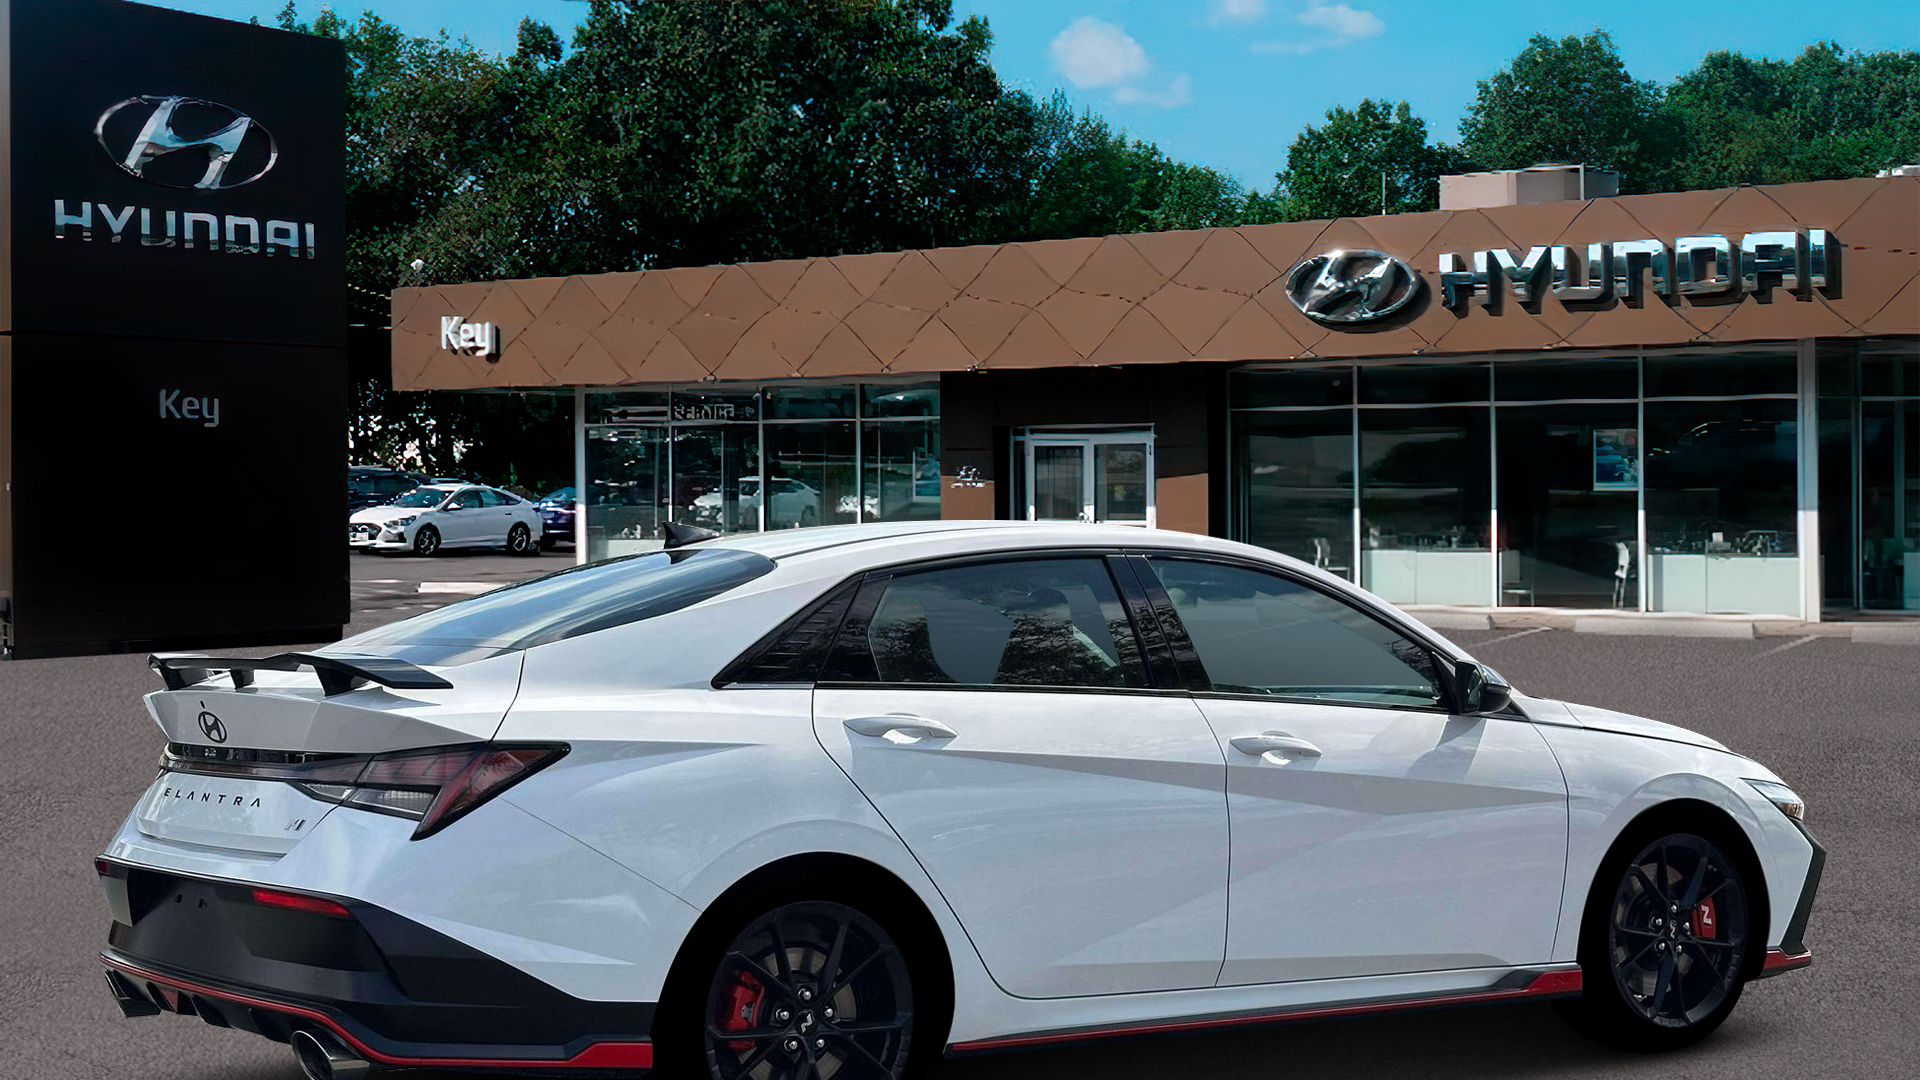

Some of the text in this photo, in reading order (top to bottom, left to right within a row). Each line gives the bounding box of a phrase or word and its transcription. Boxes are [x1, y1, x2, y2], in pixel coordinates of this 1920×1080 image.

[54, 199, 315, 259] HYUNDAI
[1438, 229, 1839, 317] HYUNDAI
[440, 315, 497, 357] Key
[159, 388, 220, 427] Key
[164, 787, 261, 808] ELANTRA
